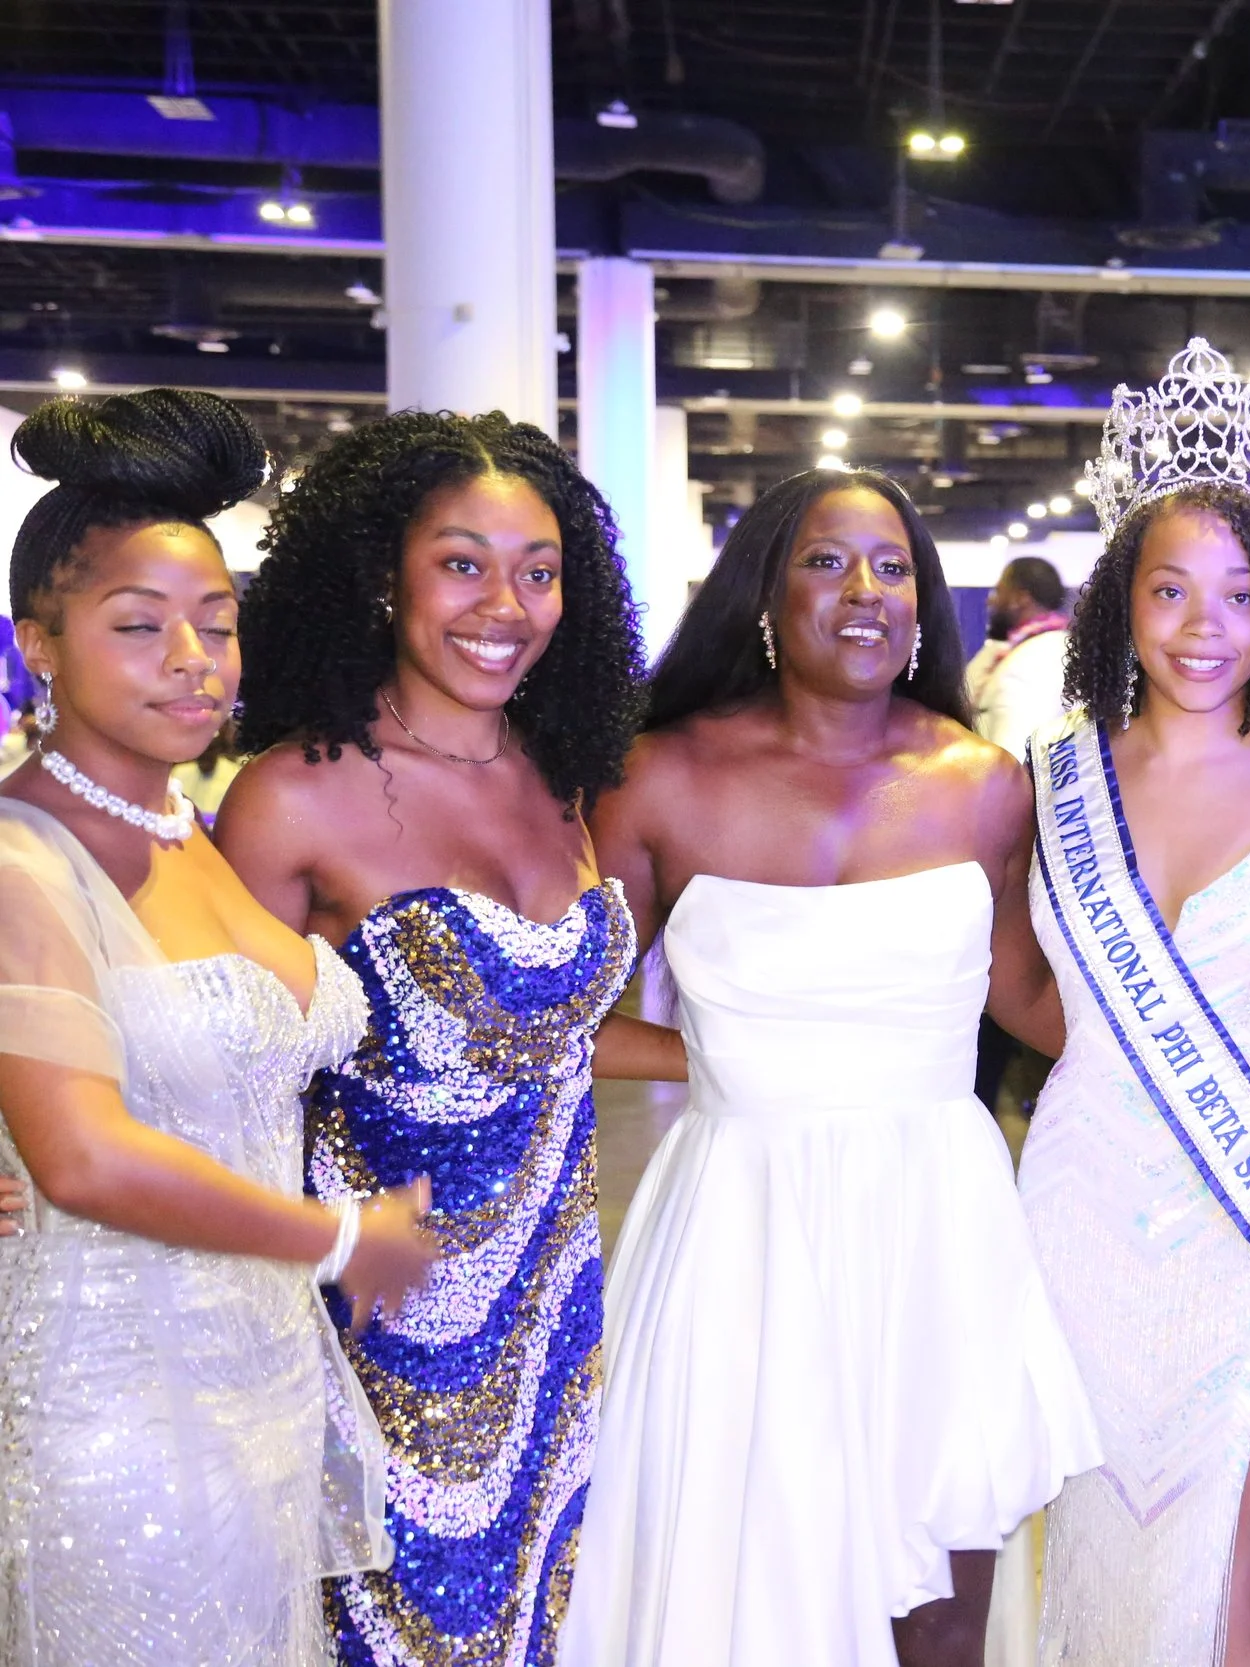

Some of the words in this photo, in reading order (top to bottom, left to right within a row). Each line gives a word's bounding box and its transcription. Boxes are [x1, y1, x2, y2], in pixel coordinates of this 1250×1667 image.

[1048, 732, 1079, 793] MISS
[1054, 795, 1166, 1022] INTERNATIONAL
[1152, 1021, 1204, 1077] PHI
[1186, 1074, 1248, 1156] BETA
